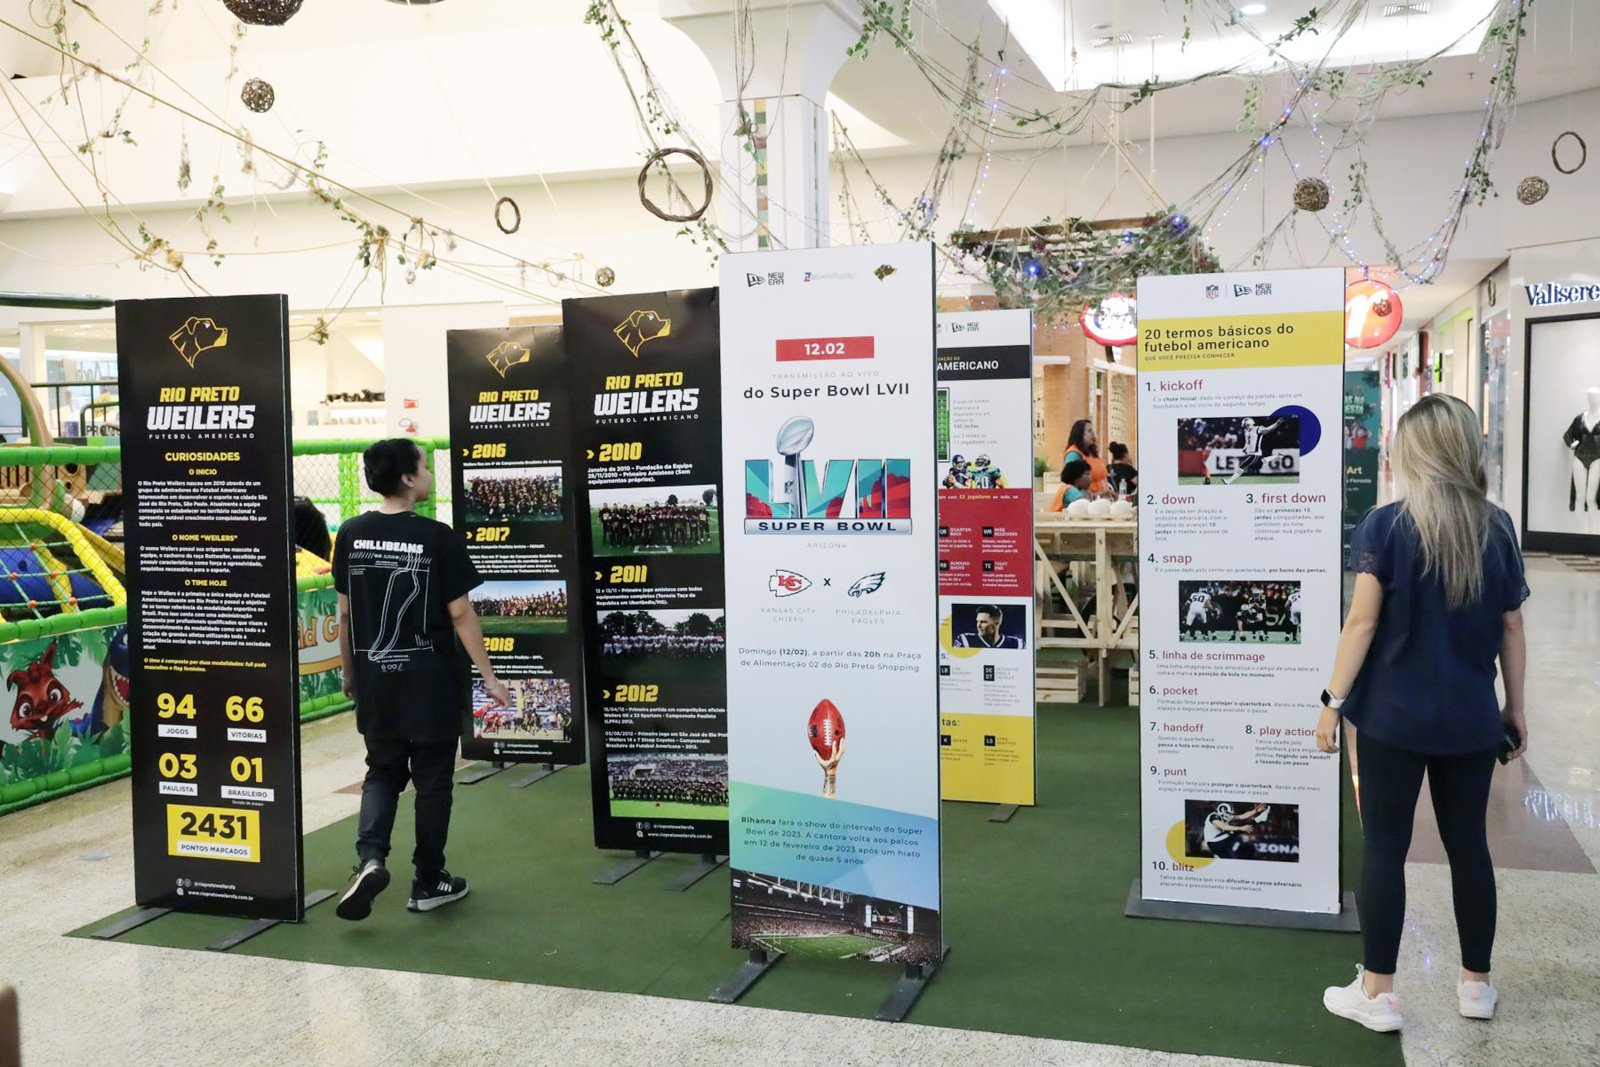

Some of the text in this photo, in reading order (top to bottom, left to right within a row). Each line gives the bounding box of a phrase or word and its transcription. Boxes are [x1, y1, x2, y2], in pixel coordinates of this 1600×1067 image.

[1145, 323, 1293, 339] 20 termos básicos do
[804, 342, 844, 354] 12.02
[1144, 340, 1268, 351] futebol americano
[937, 360, 999, 370] AMERICANO
[605, 372, 683, 390] RIO PRETO
[1146, 379, 1202, 391] 1. kickoff
[160, 386, 239, 402] RIO PRETO
[478, 390, 538, 402] RIO PRETO
[743, 383, 908, 398] do Super Bowl LVII
[594, 388, 699, 416] WEILERS
[147, 404, 255, 430] WEILERS
[469, 402, 550, 423] WEILERS
[643, 414, 699, 422] AMERICANO
[165, 452, 240, 460] CURIOSIDADES
[472, 443, 506, 459] 2016
[599, 442, 641, 461] 2010
[1146, 494, 1156, 504] 2.
[1246, 492, 1325, 503] 3. first down
[759, 521, 895, 530] SUPER BOWL
[476, 526, 509, 542] 2017
[353, 539, 423, 554] CHILLIBEANS
[1147, 553, 1191, 563] 4. snap
[610, 565, 647, 583] 2011
[1149, 649, 1264, 661] 5. linha de scrimmage
[615, 684, 658, 702] 2012
[1149, 685, 1158, 694] 6.
[157, 693, 196, 719] 94
[226, 696, 263, 722] 66
[1150, 722, 1203, 732] 7. handoff
[1245, 724, 1255, 734] 8.
[1260, 727, 1281, 736] play
[231, 731, 263, 739] VITÓRIAS
[159, 752, 196, 778] 03
[230, 756, 262, 782] 01
[1150, 766, 1186, 777] 9. punt
[228, 789, 268, 798] BRASILEIRO
[181, 812, 246, 839] 2431
[741, 816, 775, 824] Rihanna
[897, 827, 922, 835] Super
[890, 838, 918, 846] palcos
[783, 841, 819, 850] fevereiro
[836, 844, 855, 852] 2023
[898, 849, 921, 857] hiato
[1152, 861, 1194, 873] 10. blitz
